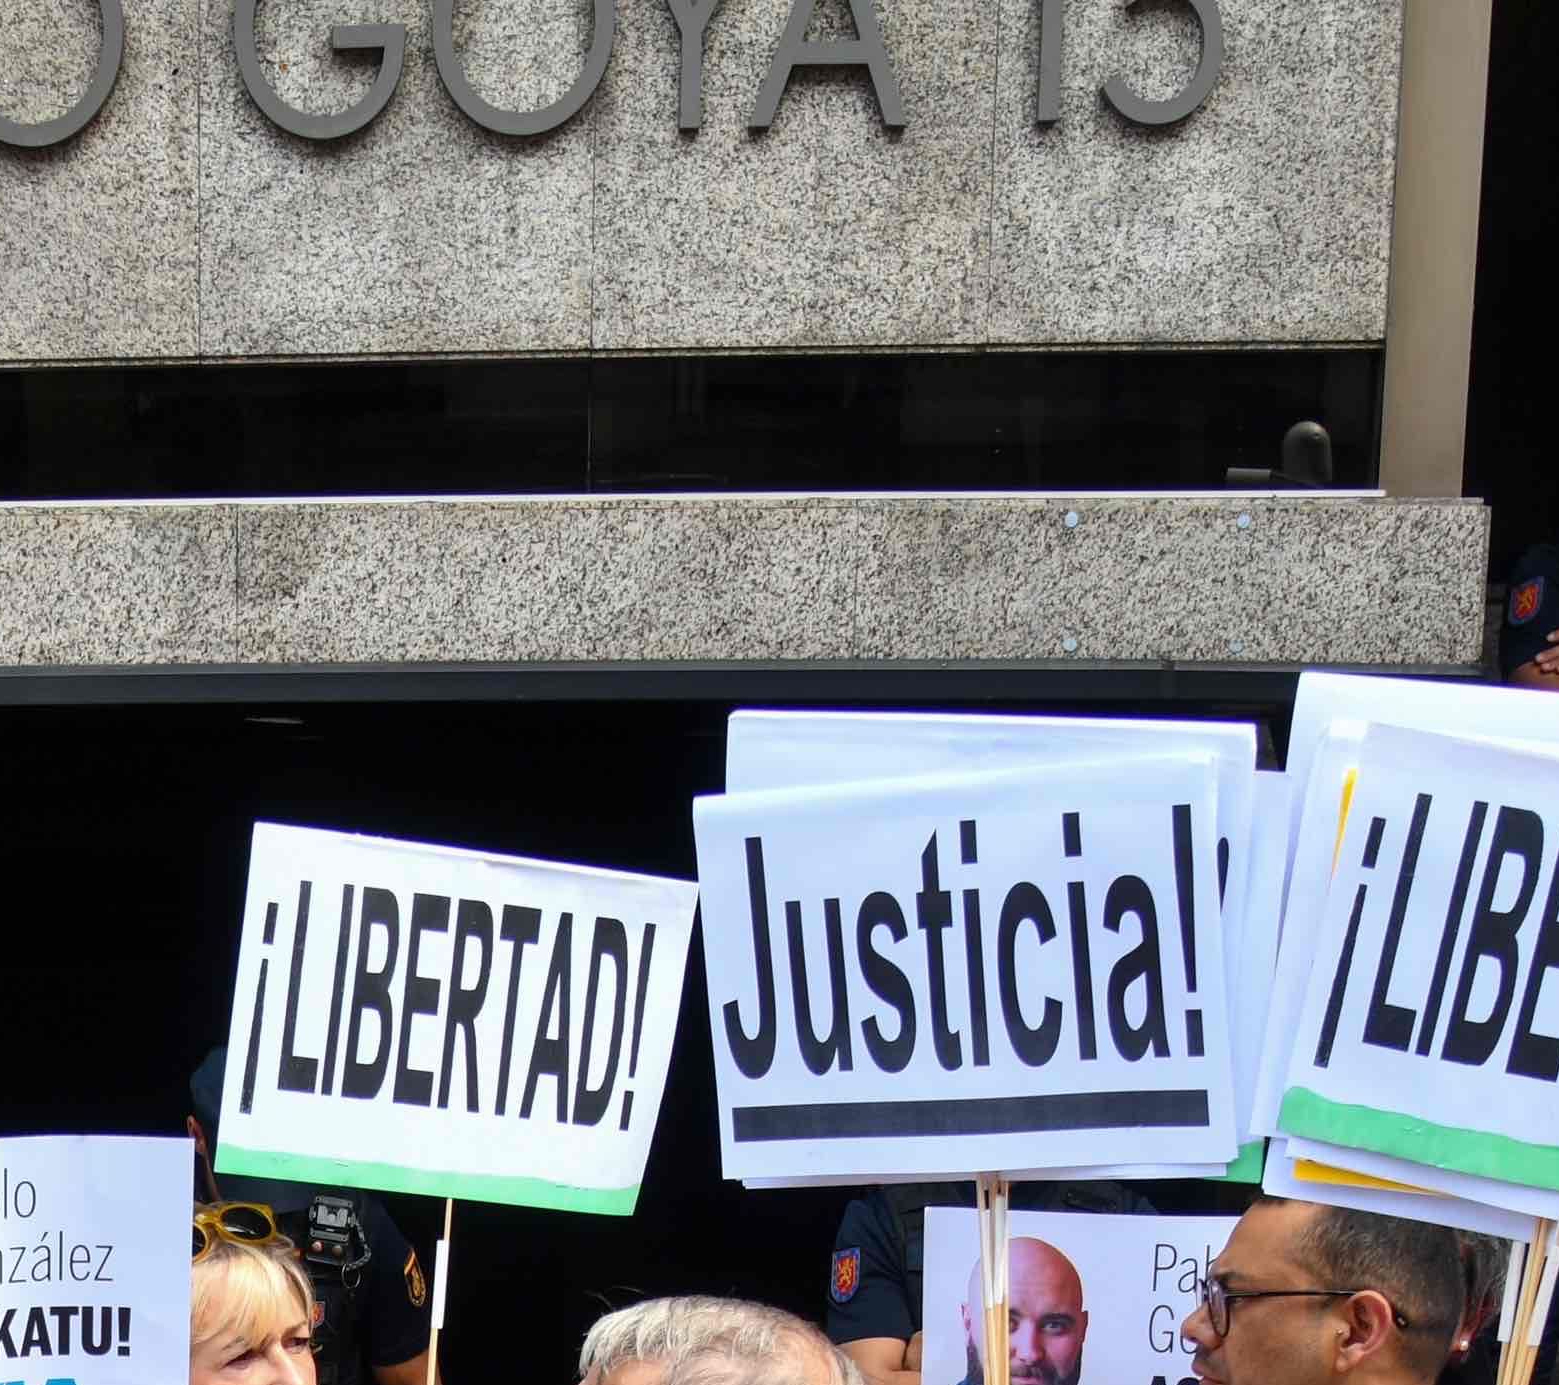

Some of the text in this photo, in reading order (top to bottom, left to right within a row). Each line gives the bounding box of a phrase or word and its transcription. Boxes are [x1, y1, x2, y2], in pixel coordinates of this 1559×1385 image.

[235, 0, 905, 140] GOYA
[239, 880, 658, 1132] ¡LIBERTAD!
[722, 804, 1205, 1081] Justicia!
